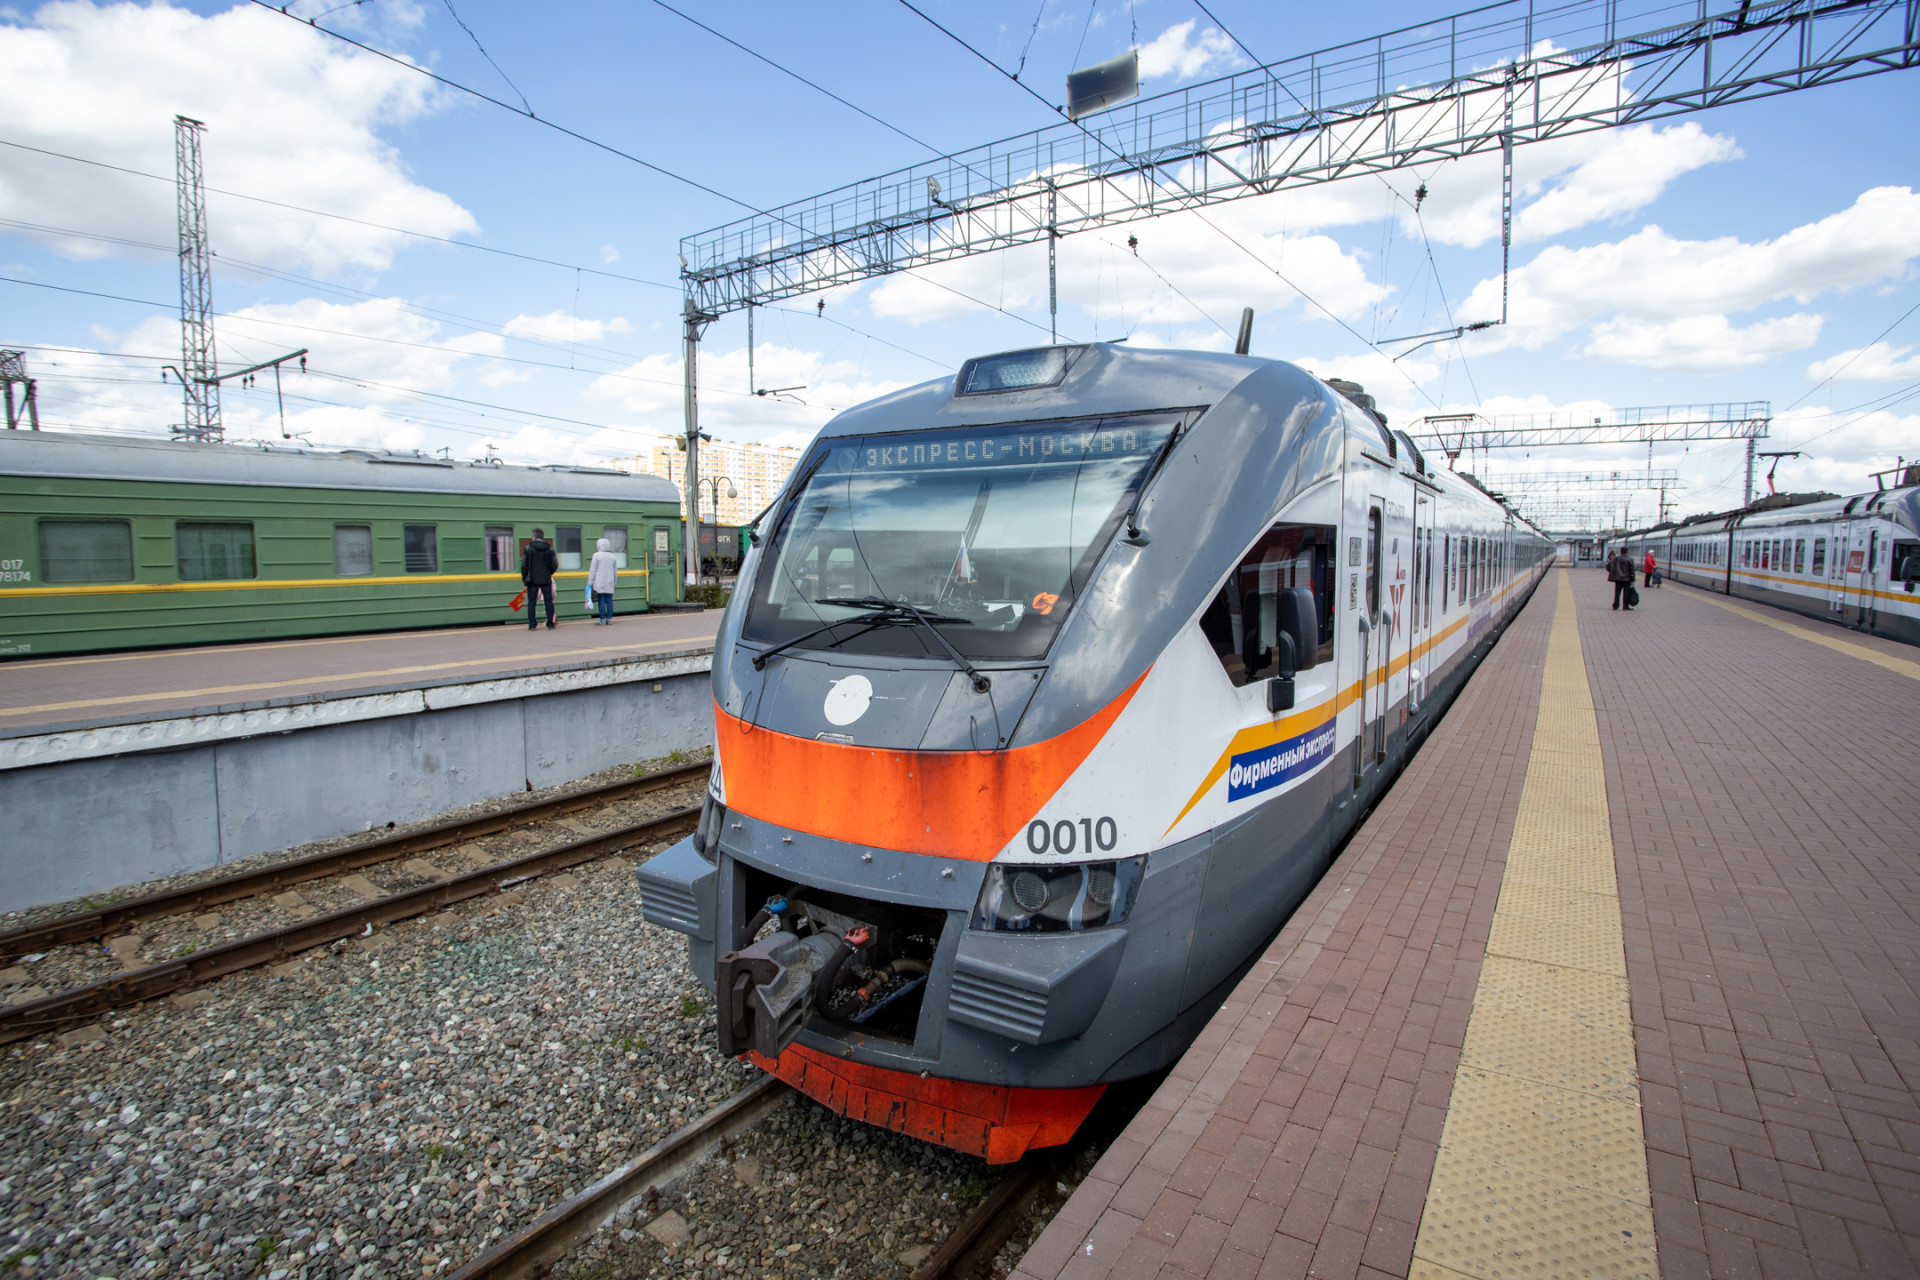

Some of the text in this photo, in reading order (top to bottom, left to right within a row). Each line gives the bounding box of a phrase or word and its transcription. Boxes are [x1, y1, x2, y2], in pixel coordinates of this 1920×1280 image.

[717, 535, 731, 543] ФГК
[1, 559, 24, 570] 017
[1230, 727, 1335, 789] Фирменный экспресс
[1026, 816, 1118, 855] 0010
